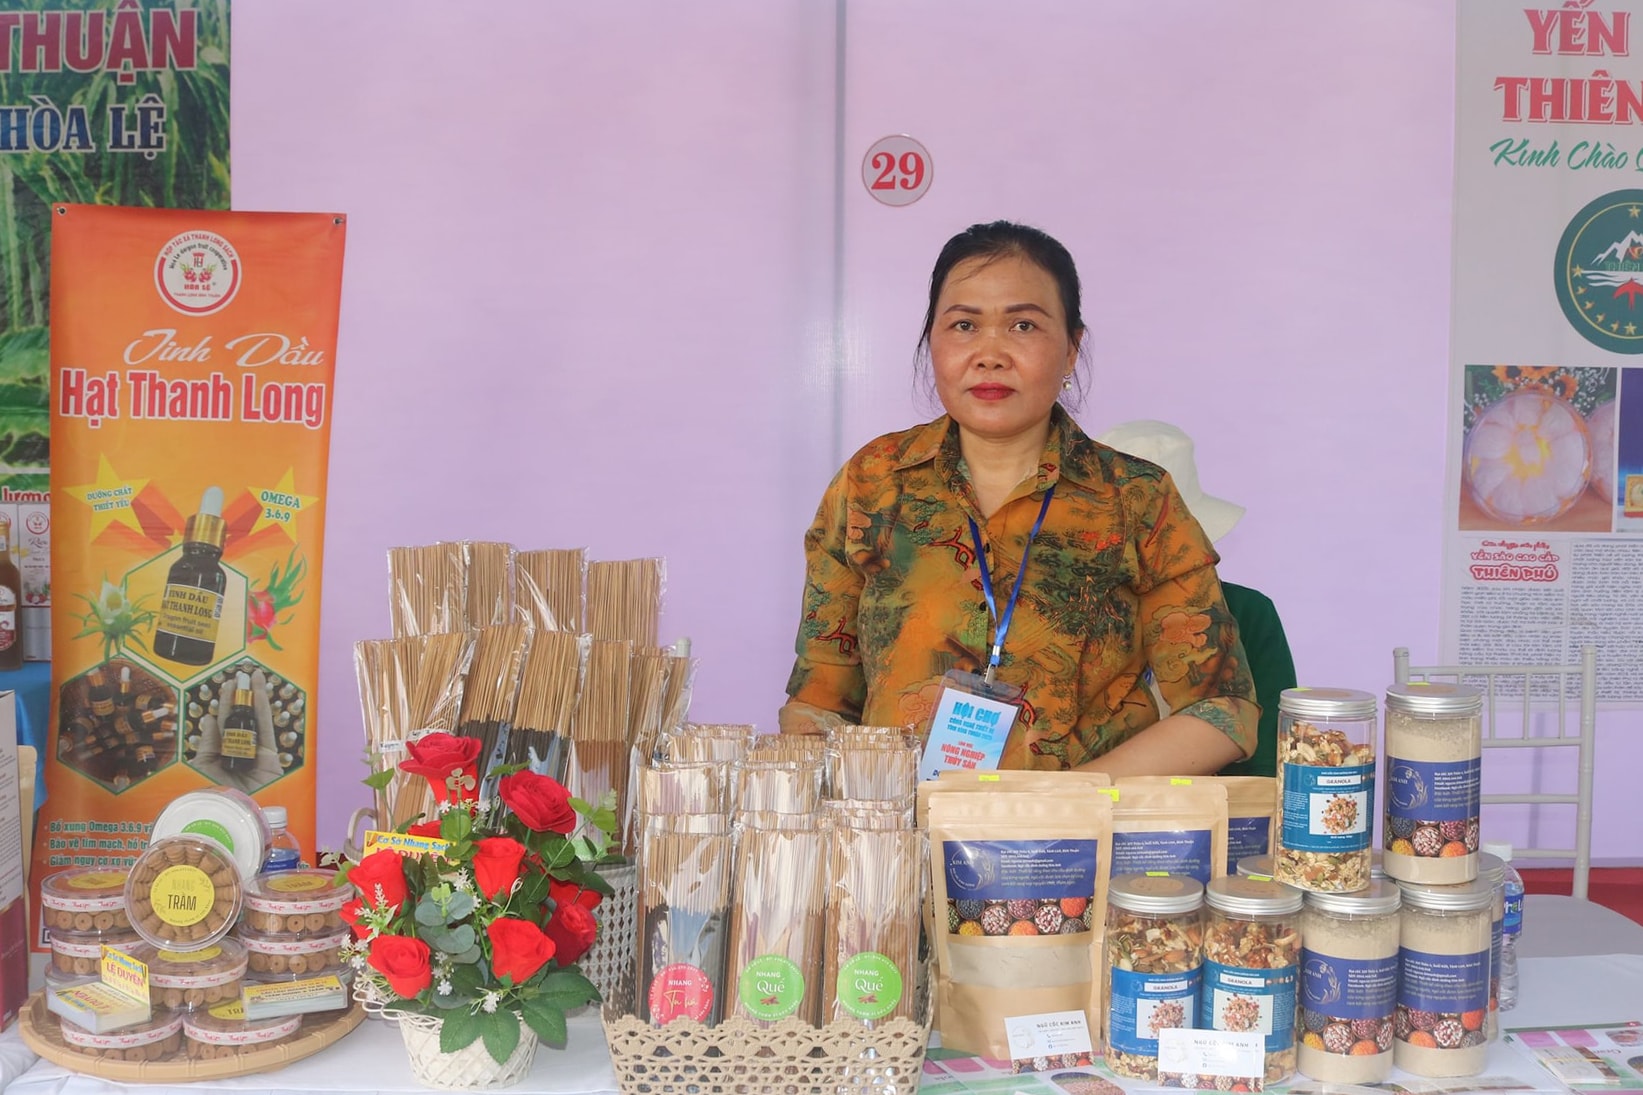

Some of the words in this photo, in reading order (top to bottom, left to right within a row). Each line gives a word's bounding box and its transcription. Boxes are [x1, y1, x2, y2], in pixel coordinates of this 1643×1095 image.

[1523, 0, 1631, 57] YẾN
[0, 0, 198, 85] THUẬN
[1493, 69, 1643, 125] THIÊN
[107, 93, 167, 160] LỆ
[1567, 140, 1629, 171] Chào
[871, 151, 925, 191] 29
[60, 368, 121, 429] Hạt
[126, 370, 233, 421] Thanh
[241, 372, 326, 431] Long
[261, 490, 301, 510] OMEGA
[265, 508, 291, 524] 3.6.9
[1470, 563, 1520, 580] THIÊN
[1520, 563, 1559, 582] PHÚ
[952, 701, 974, 719] HỘI
[975, 707, 1002, 727] CHỢ
[940, 743, 961, 755] NÔNG
[960, 749, 986, 761] NGHIỆP
[64, 822, 87, 834] xung
[89, 820, 119, 834] Omega
[120, 822, 142, 833] 3.6.9
[74, 855, 95, 867] nguy
[756, 970, 781, 978] NHANG
[854, 968, 880, 977] NHANG
[668, 979, 692, 987] NHANG
[757, 977, 785, 995] Quế
[855, 975, 884, 994] Quế
